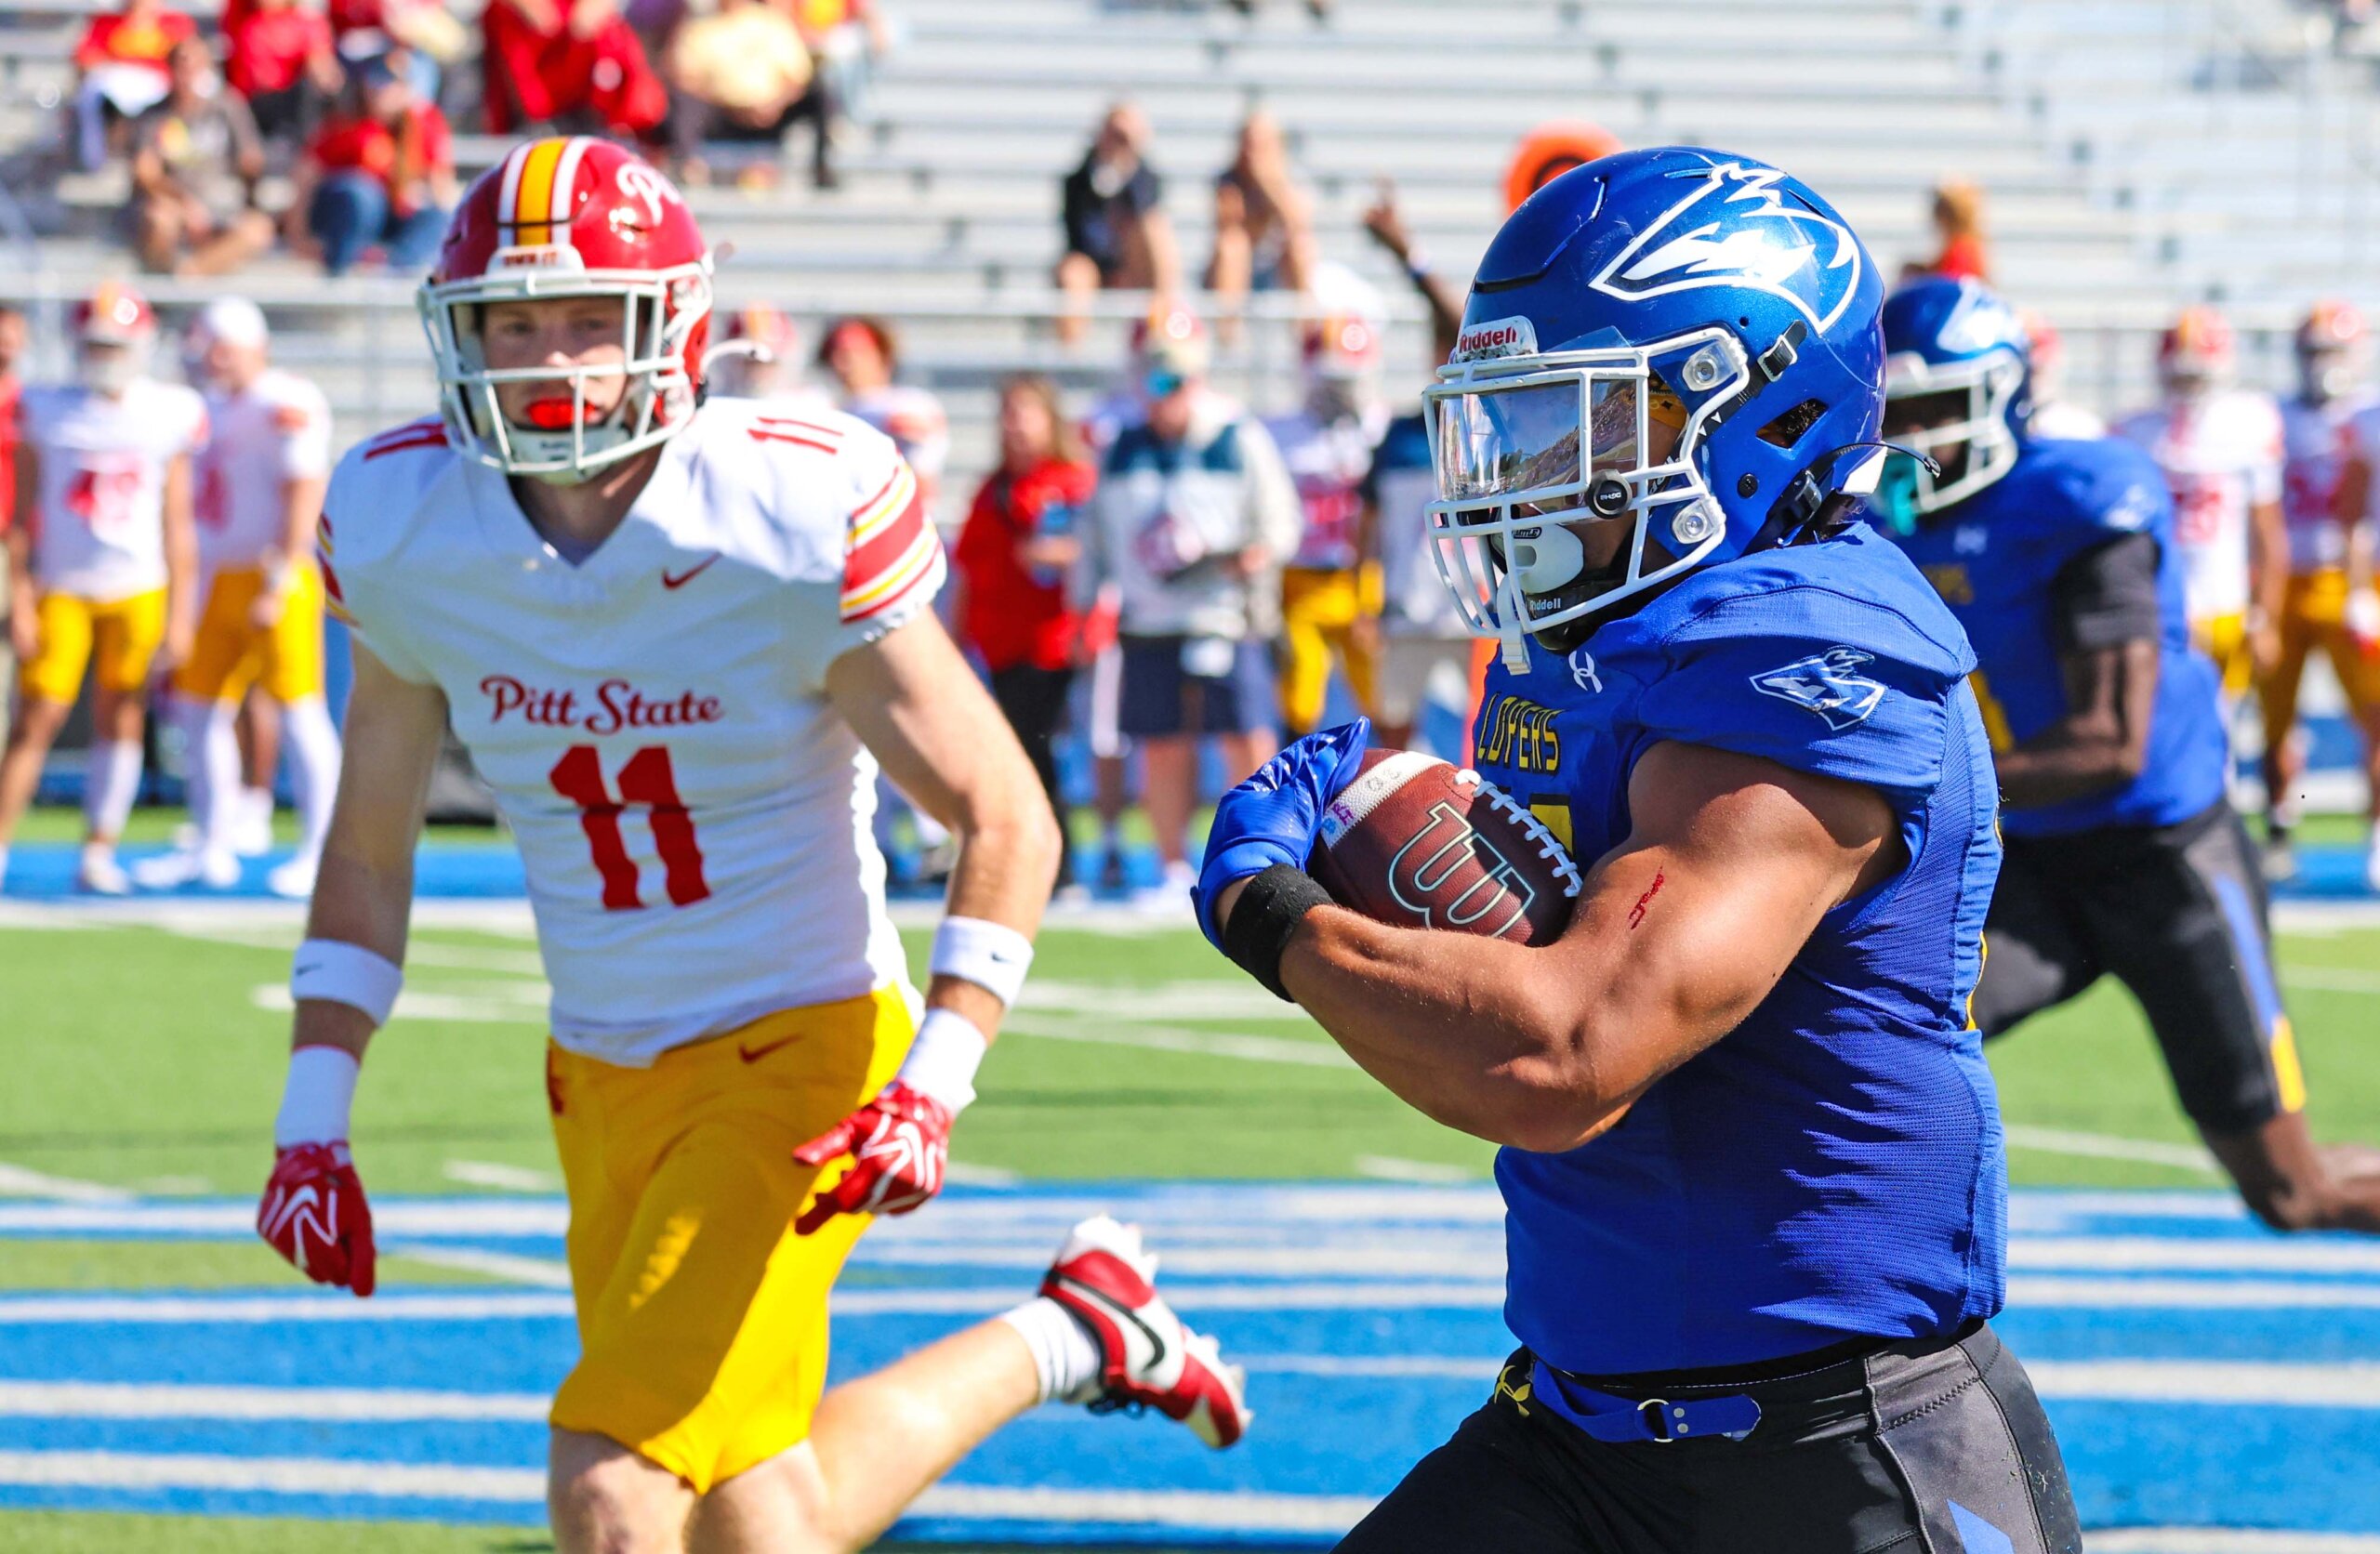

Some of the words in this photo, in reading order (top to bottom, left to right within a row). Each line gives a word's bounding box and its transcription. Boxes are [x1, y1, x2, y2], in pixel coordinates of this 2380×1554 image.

[1459, 326, 1517, 353] Riddell
[480, 675, 578, 726] Pitt
[585, 679, 726, 735] State
[1476, 692, 1566, 774] LOPERS
[549, 744, 712, 910] 11
